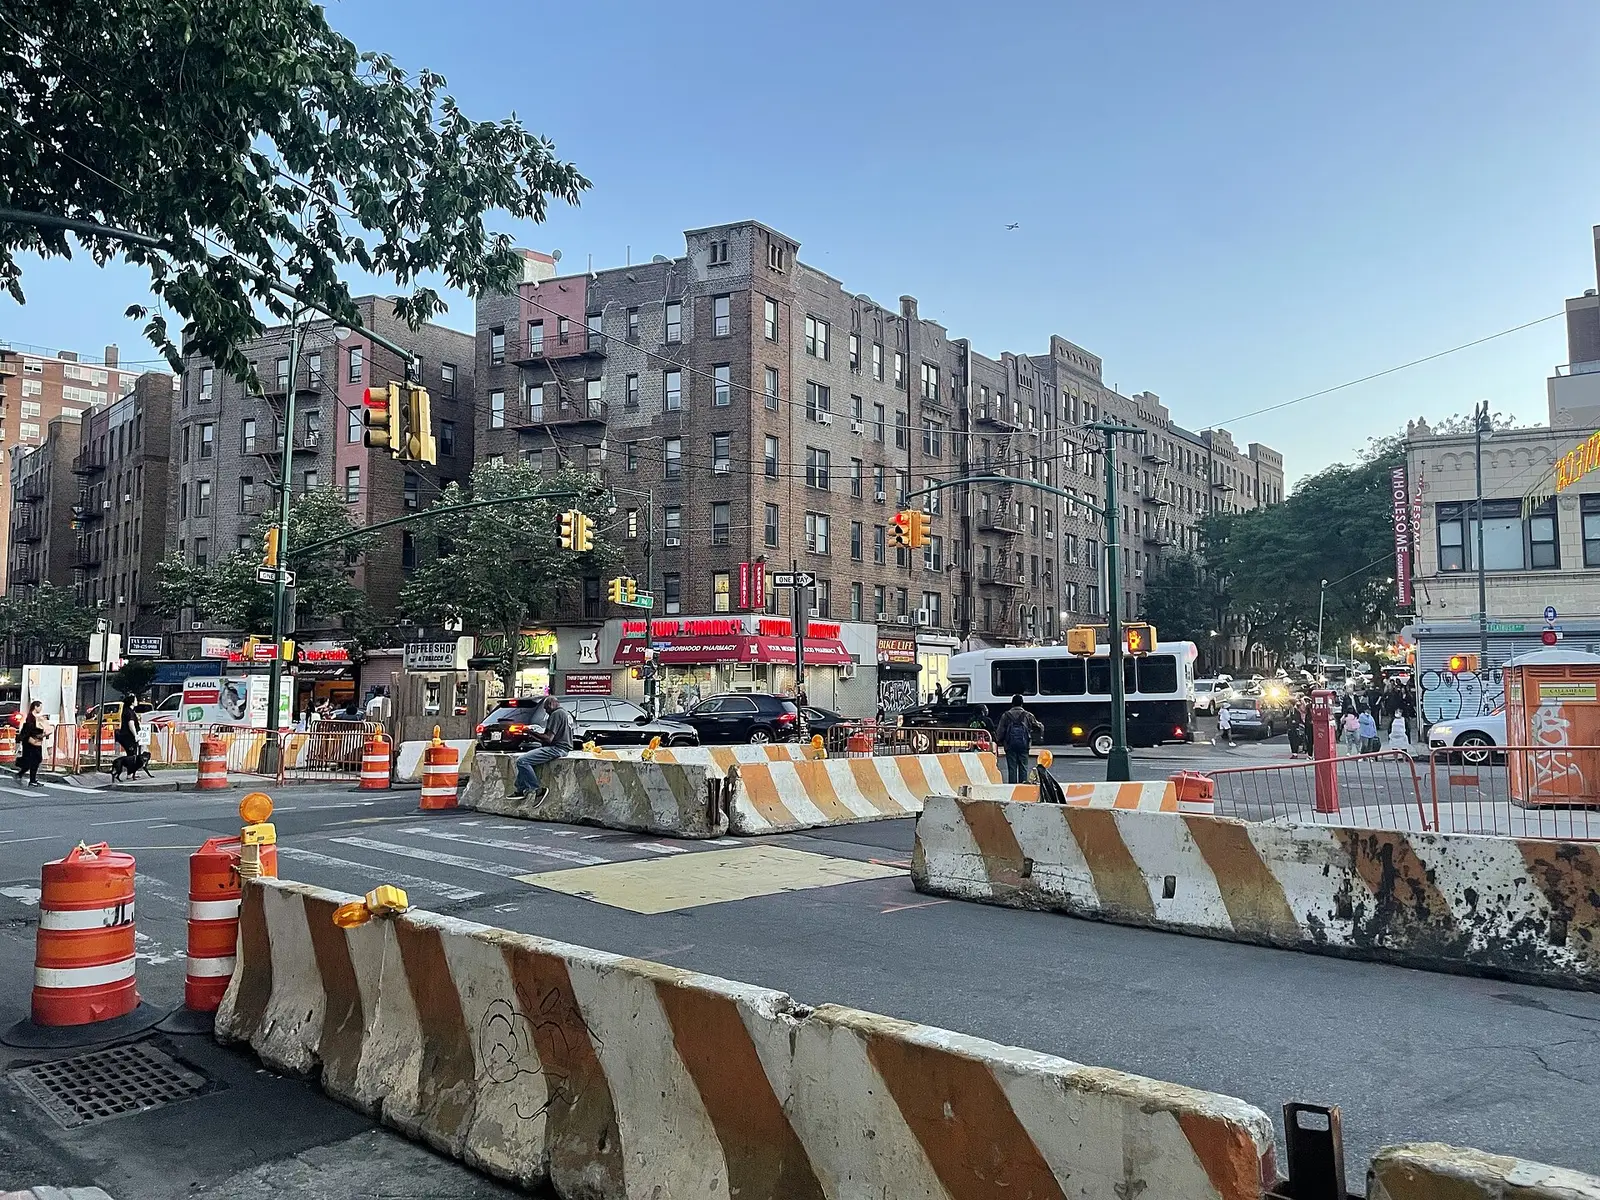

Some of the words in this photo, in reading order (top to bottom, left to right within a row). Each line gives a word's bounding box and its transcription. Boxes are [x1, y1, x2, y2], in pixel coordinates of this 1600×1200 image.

[1392, 467, 1408, 553] WHOLESOME
[779, 575, 793, 583] ONE
[683, 618, 742, 637] PHARMACY
[405, 644, 433, 655] COFFEE
[434, 643, 457, 654] SHOP
[702, 644, 738, 652] PHARMACY
[878, 640, 897, 649] BIKE
[897, 641, 914, 651] LIFE
